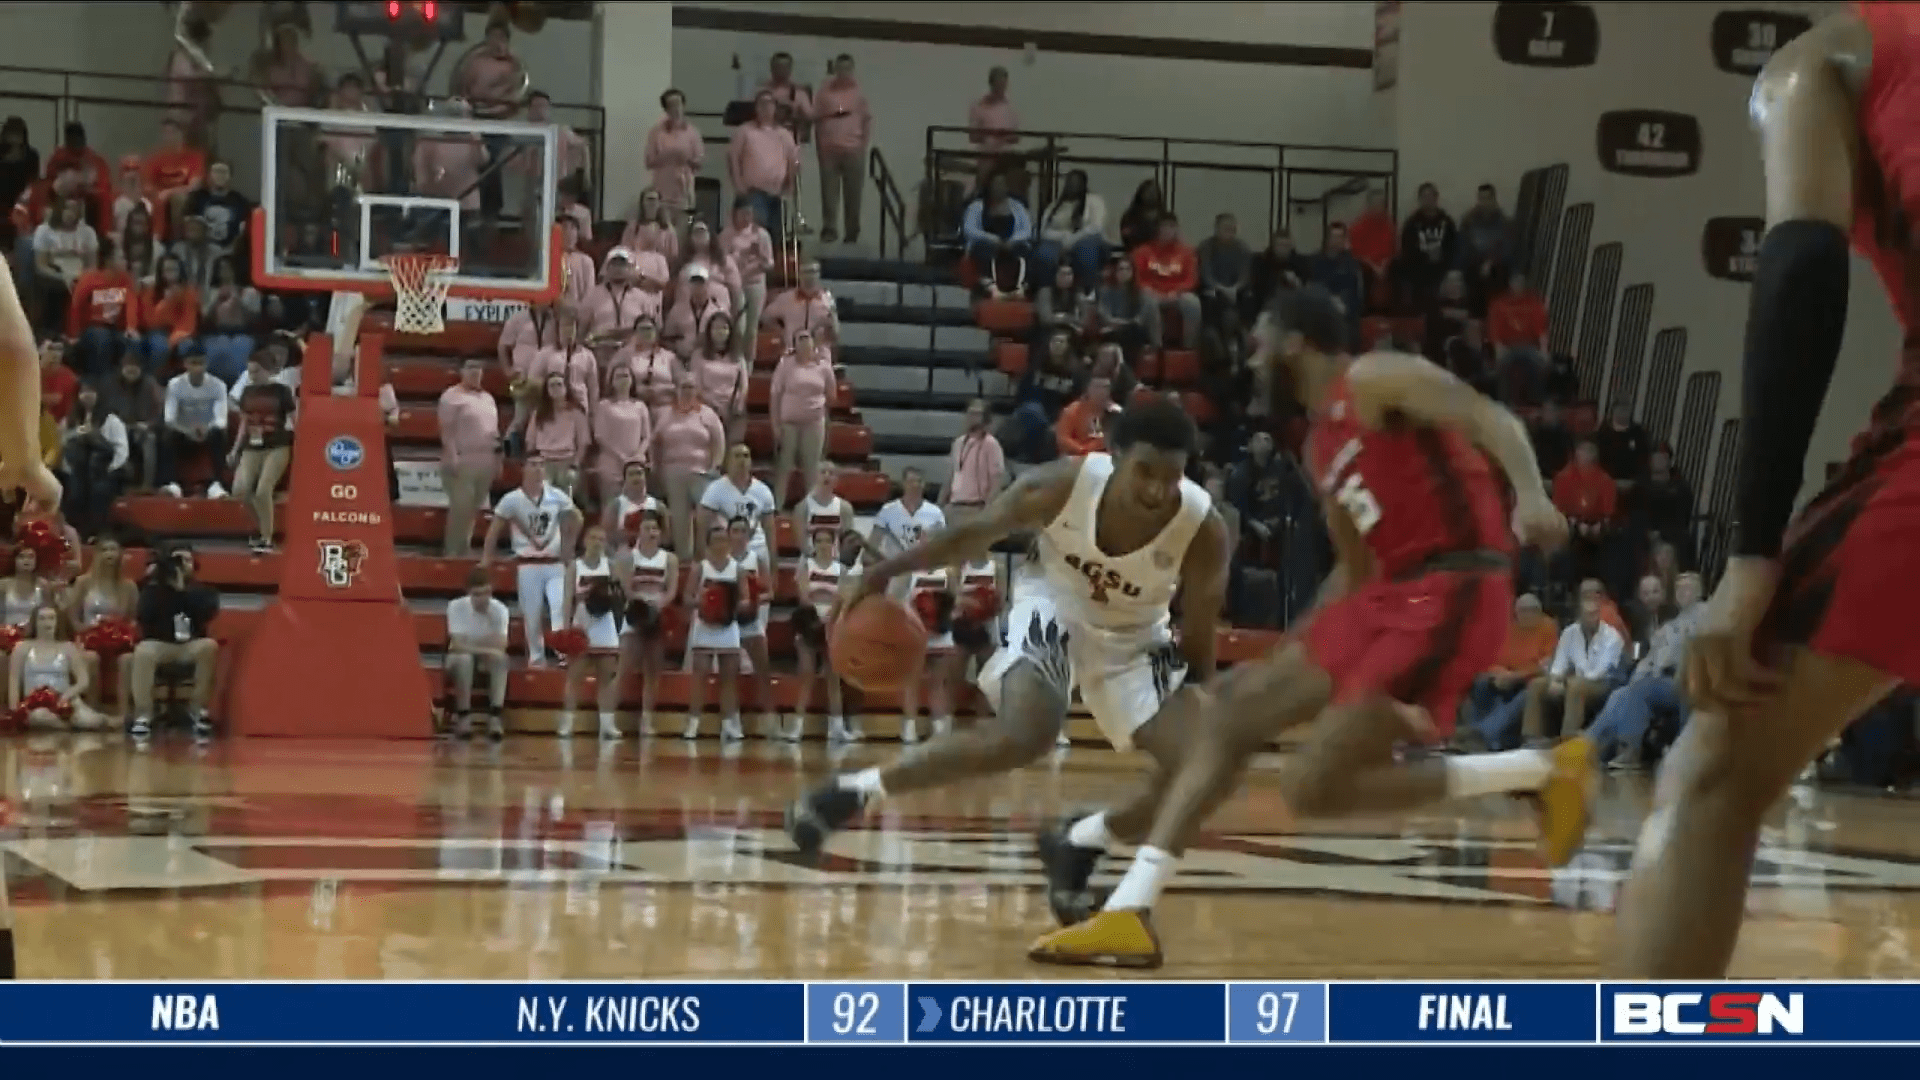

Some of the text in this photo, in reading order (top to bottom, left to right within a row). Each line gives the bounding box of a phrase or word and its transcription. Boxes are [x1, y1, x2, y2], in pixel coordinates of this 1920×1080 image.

[1637, 122, 1665, 148] 42
[330, 484, 358, 500] GO
[312, 510, 382, 526] FALCONS!
